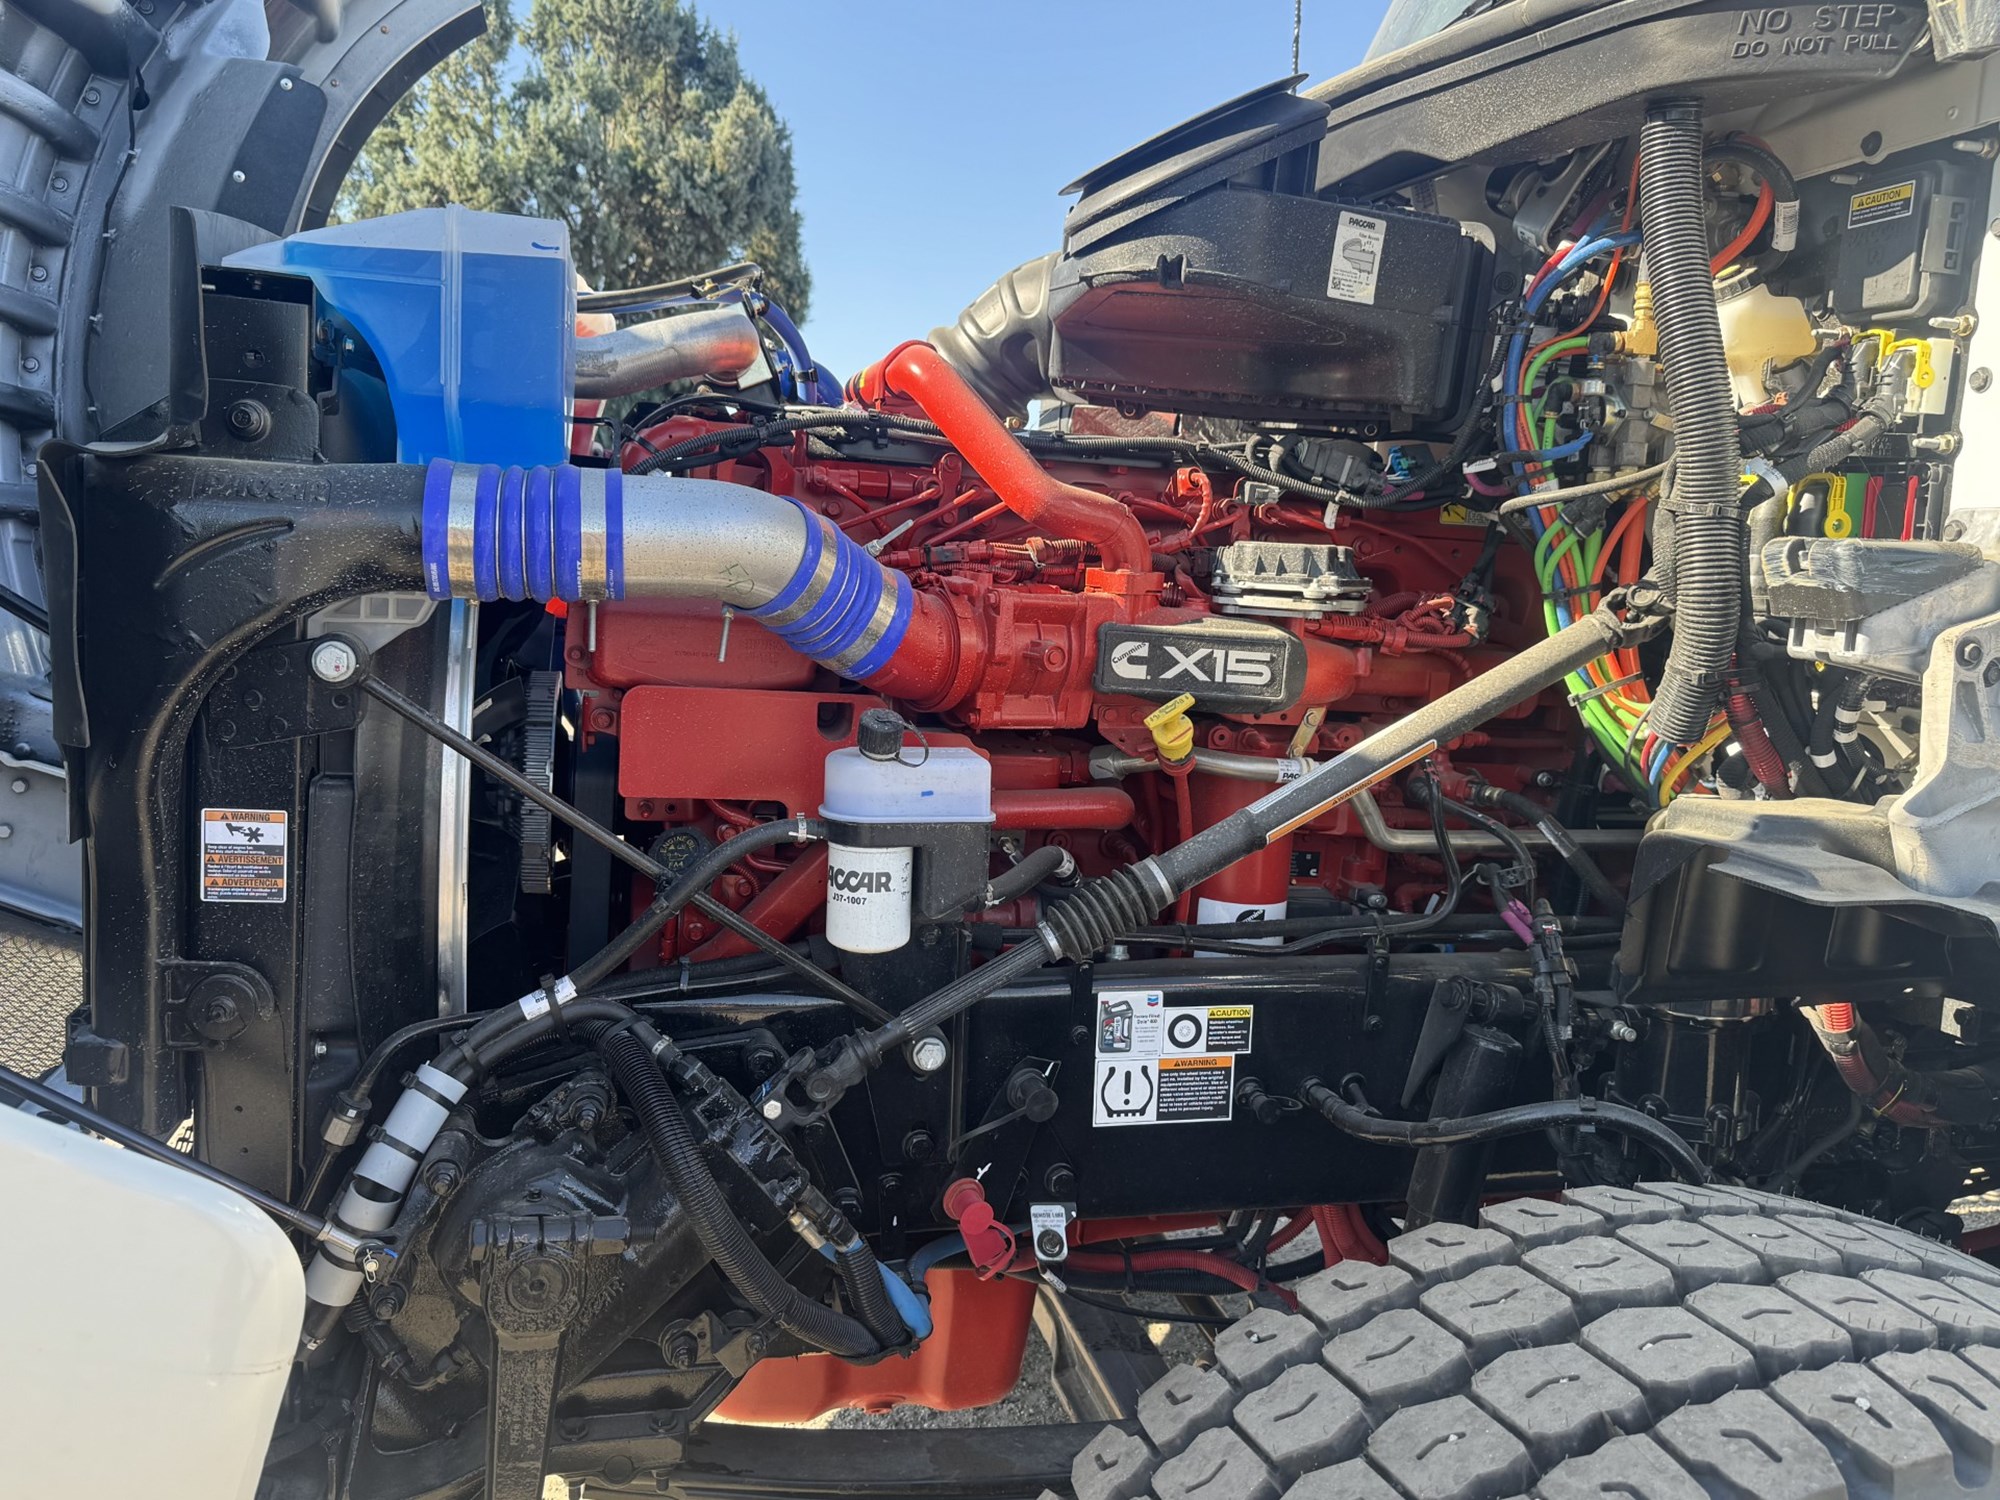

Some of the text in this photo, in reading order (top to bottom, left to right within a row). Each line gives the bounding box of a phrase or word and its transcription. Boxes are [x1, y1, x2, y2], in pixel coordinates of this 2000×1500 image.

[1738, 4, 1896, 35] NO STEP
[1731, 34, 1898, 58] DO NOT PULL
[1865, 189, 1901, 205] CAUTION
[1349, 217, 1375, 230] PACCAR
[1159, 646, 1272, 685] X15
[1338, 780, 1372, 802] WARNING
[231, 812, 270, 821] WARNING
[219, 856, 282, 864] AVERTISSEMENT
[222, 879, 279, 887] ADVERTENCIA
[828, 865, 891, 893] ACCAR
[833, 893, 867, 905] J37-1007
